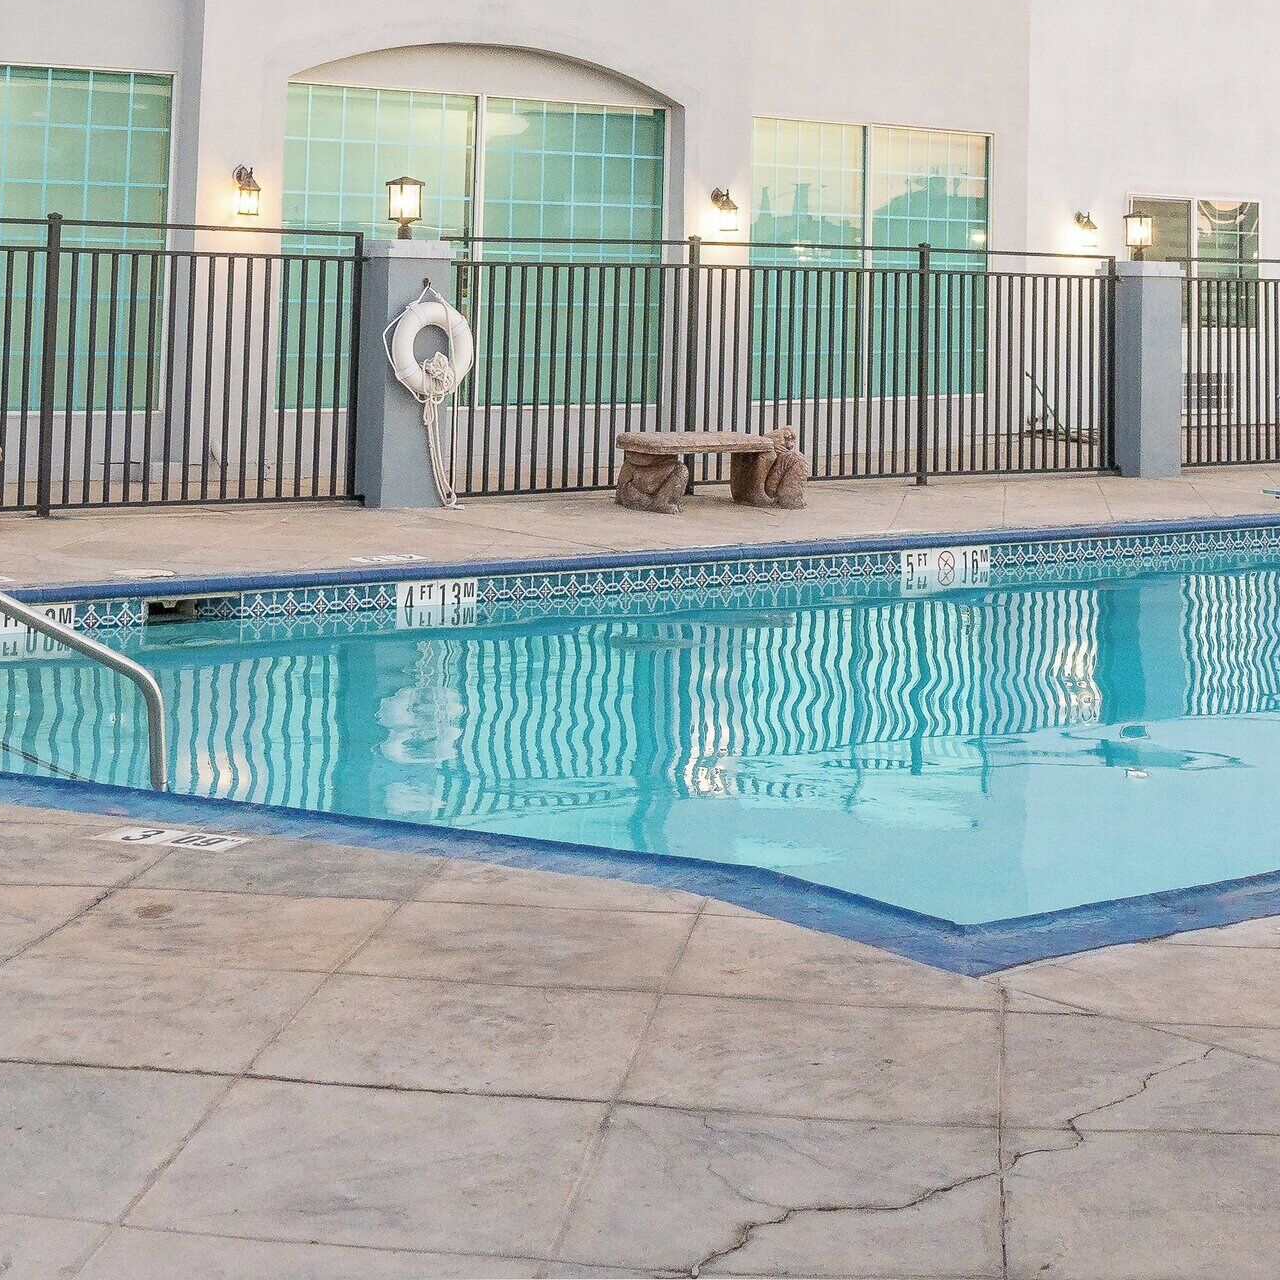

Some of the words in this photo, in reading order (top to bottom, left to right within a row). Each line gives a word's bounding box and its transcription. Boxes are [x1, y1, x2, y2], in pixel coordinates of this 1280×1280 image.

[906, 553, 914, 573] 5
[917, 552, 928, 567] FT
[404, 585, 415, 608] 4
[419, 583, 434, 600] FT
[121, 829, 166, 841] 3
